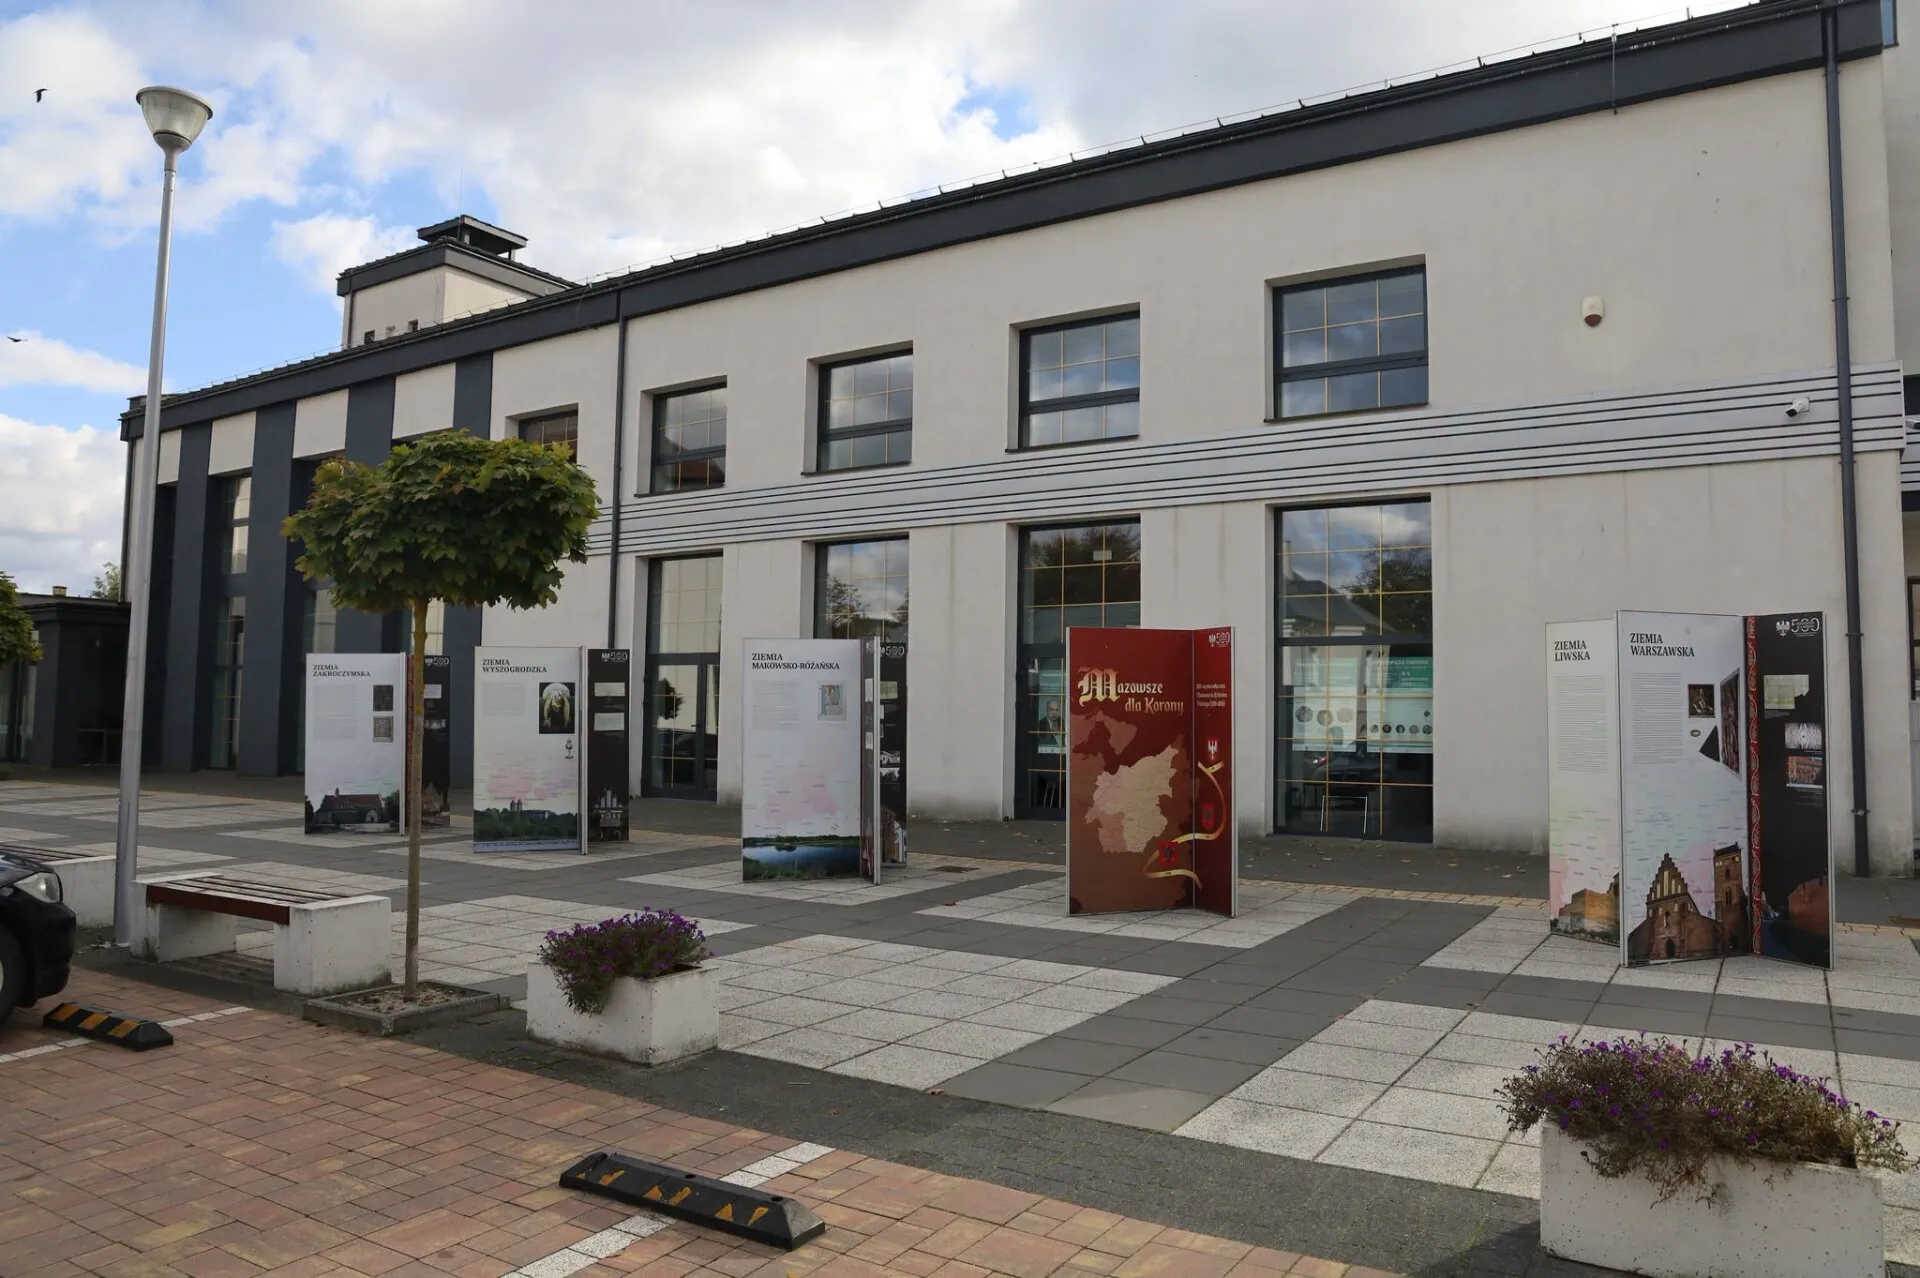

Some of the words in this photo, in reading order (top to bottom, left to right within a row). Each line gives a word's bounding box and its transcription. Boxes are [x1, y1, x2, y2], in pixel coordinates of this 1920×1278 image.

[1629, 632, 1664, 644] ZIEMIA
[1553, 640, 1588, 651] ZIEMIA
[1630, 645, 1695, 657] WARSZAWSKA
[751, 653, 784, 661] ZIEMIA
[1554, 650, 1591, 662] LIWSKA
[482, 658, 511, 666] ZIEMIA
[751, 661, 840, 670] MAKOWSKO-RÓŻAŃSKA
[482, 665, 547, 673] WYSZOGRODZKA
[1077, 666, 1164, 707] Mazowsze
[1124, 698, 1143, 713] dla
[1143, 698, 1184, 715] Korony
